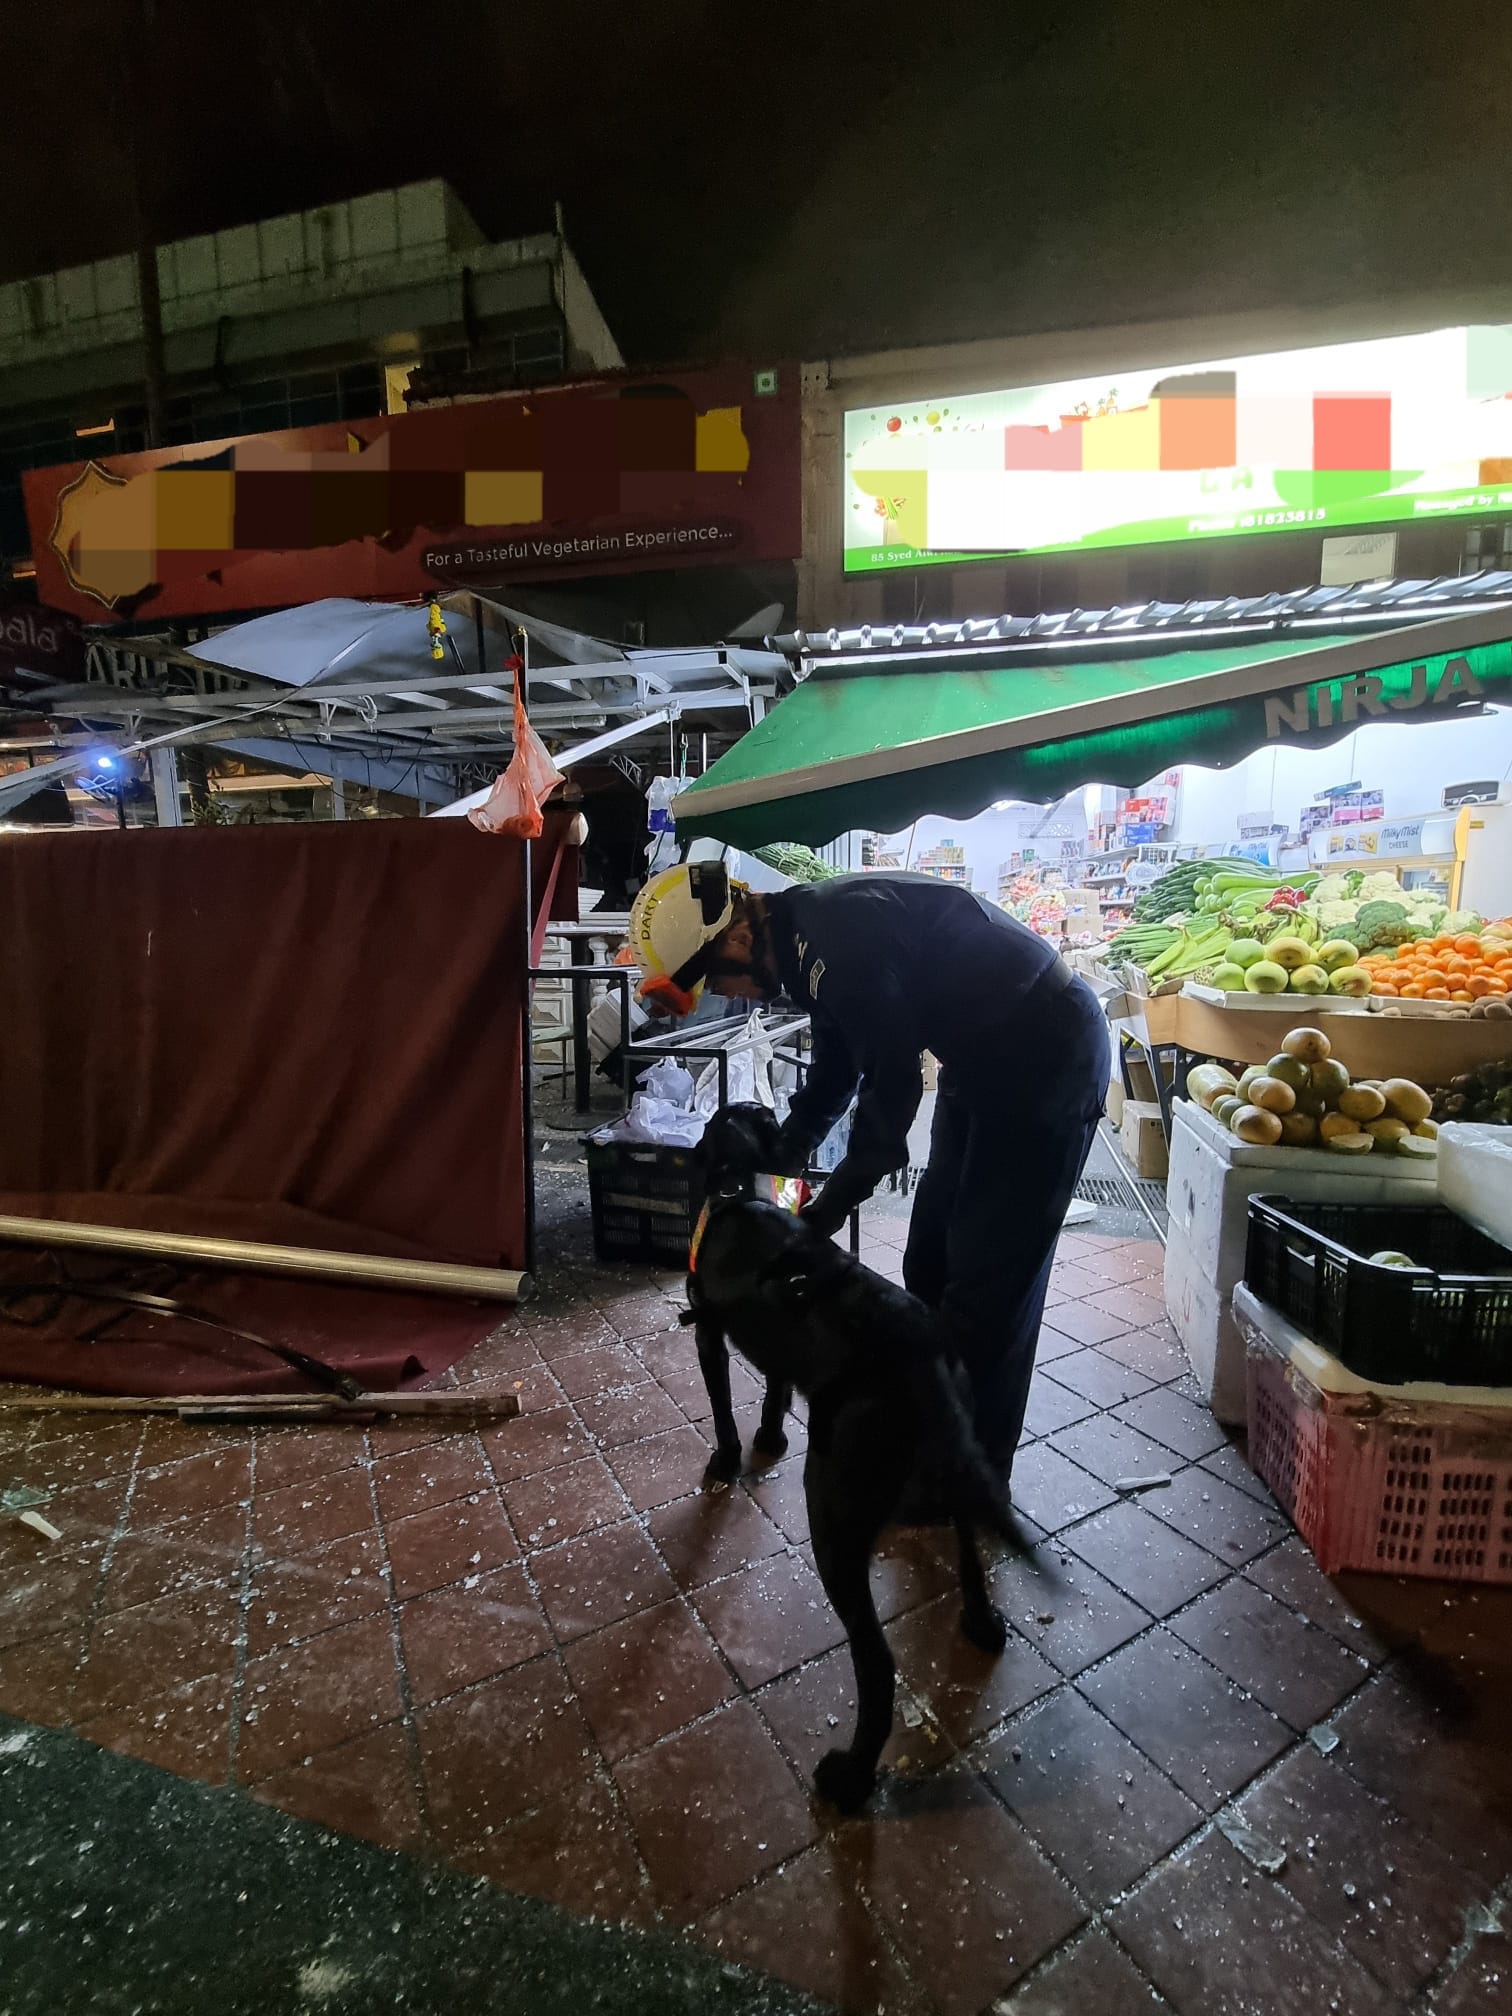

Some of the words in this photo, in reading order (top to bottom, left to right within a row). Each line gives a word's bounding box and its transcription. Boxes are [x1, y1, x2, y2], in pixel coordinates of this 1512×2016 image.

[426, 552, 451, 568] For
[453, 552, 464, 565] a
[467, 542, 528, 563] Tasteful
[532, 534, 621, 559] Vegetarian
[625, 523, 734, 549] Experience...
[871, 553, 884, 562] 85
[887, 549, 912, 563] Syed
[1264, 656, 1484, 739] NIRJA
[641, 892, 658, 941] DART
